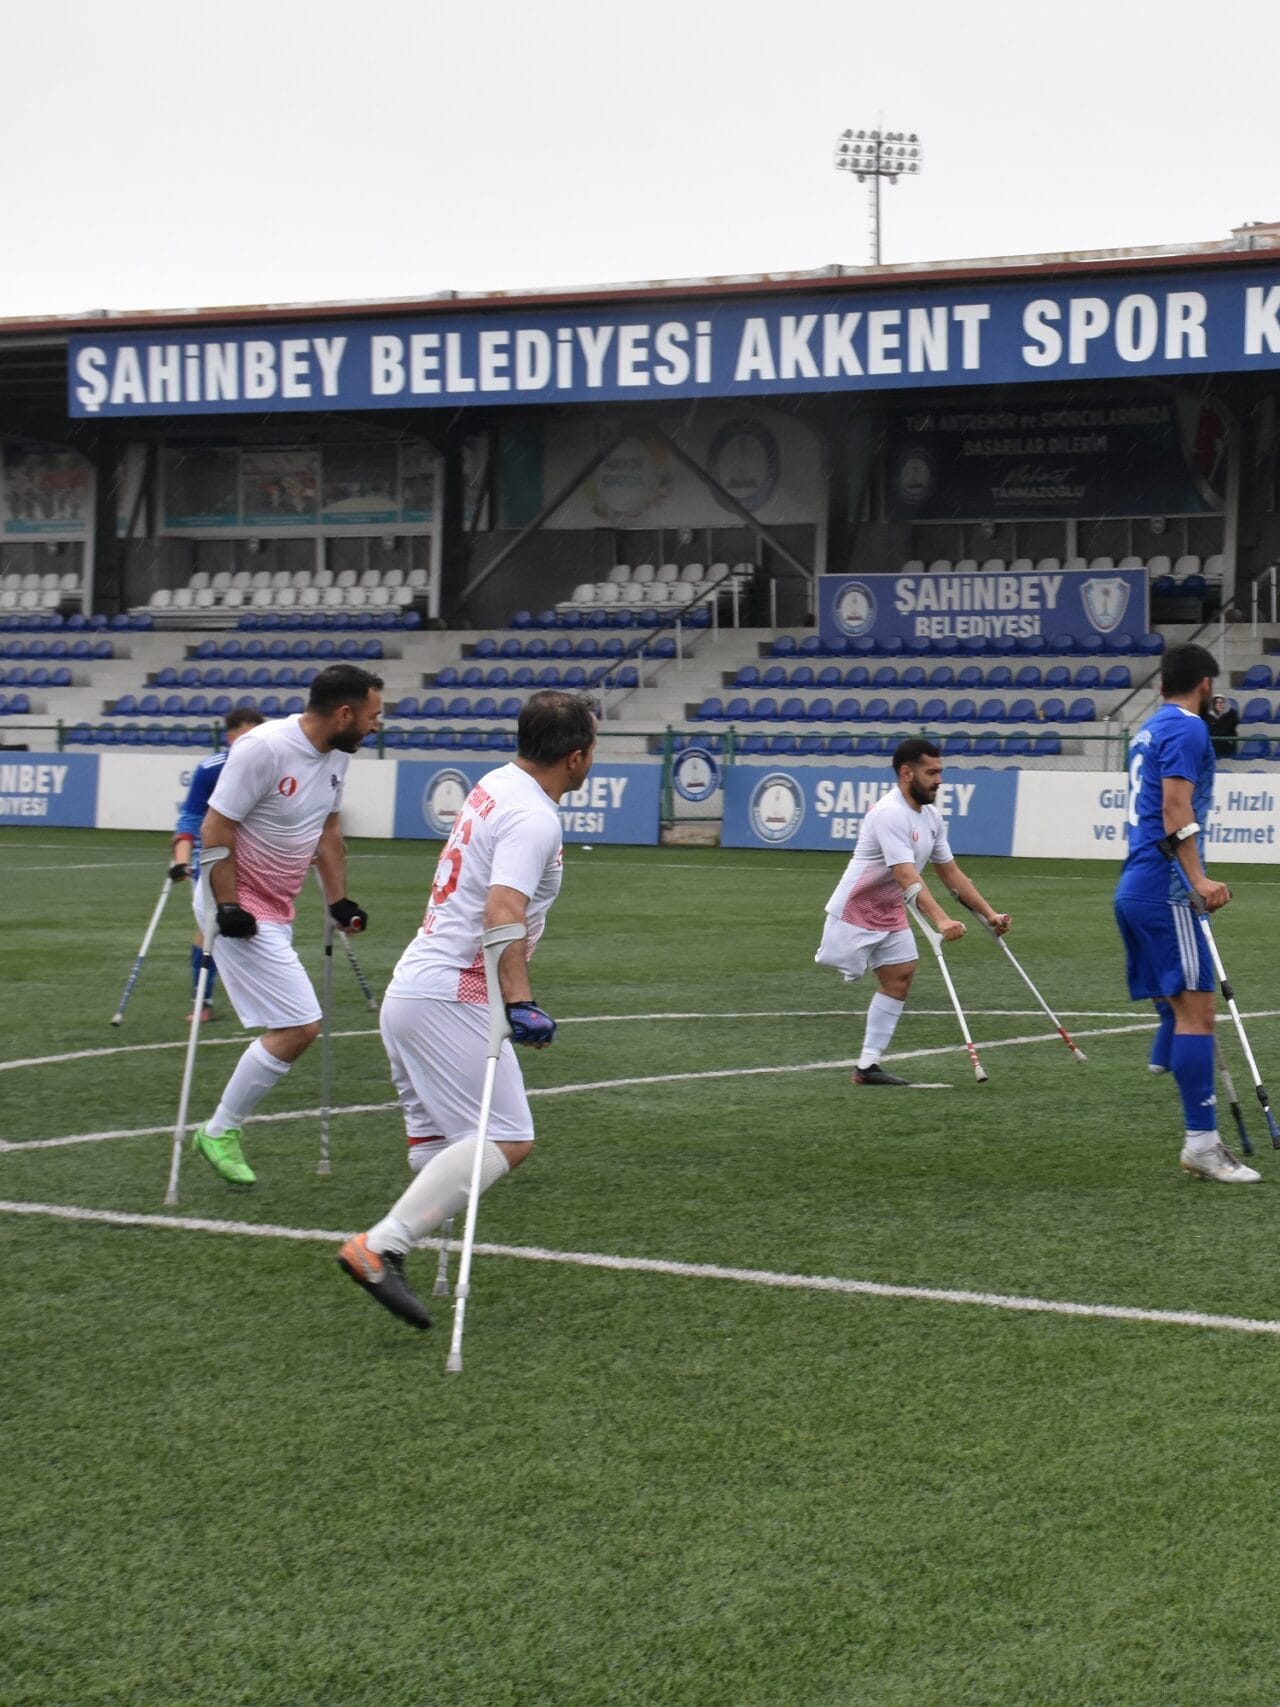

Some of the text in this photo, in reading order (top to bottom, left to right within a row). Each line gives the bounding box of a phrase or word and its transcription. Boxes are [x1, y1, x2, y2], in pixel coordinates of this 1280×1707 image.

[734, 303, 990, 381] AKKENT
[1022, 292, 1207, 366] SPOR
[1227, 790, 1274, 812] Hızlı
[1093, 824, 1117, 841] ve
